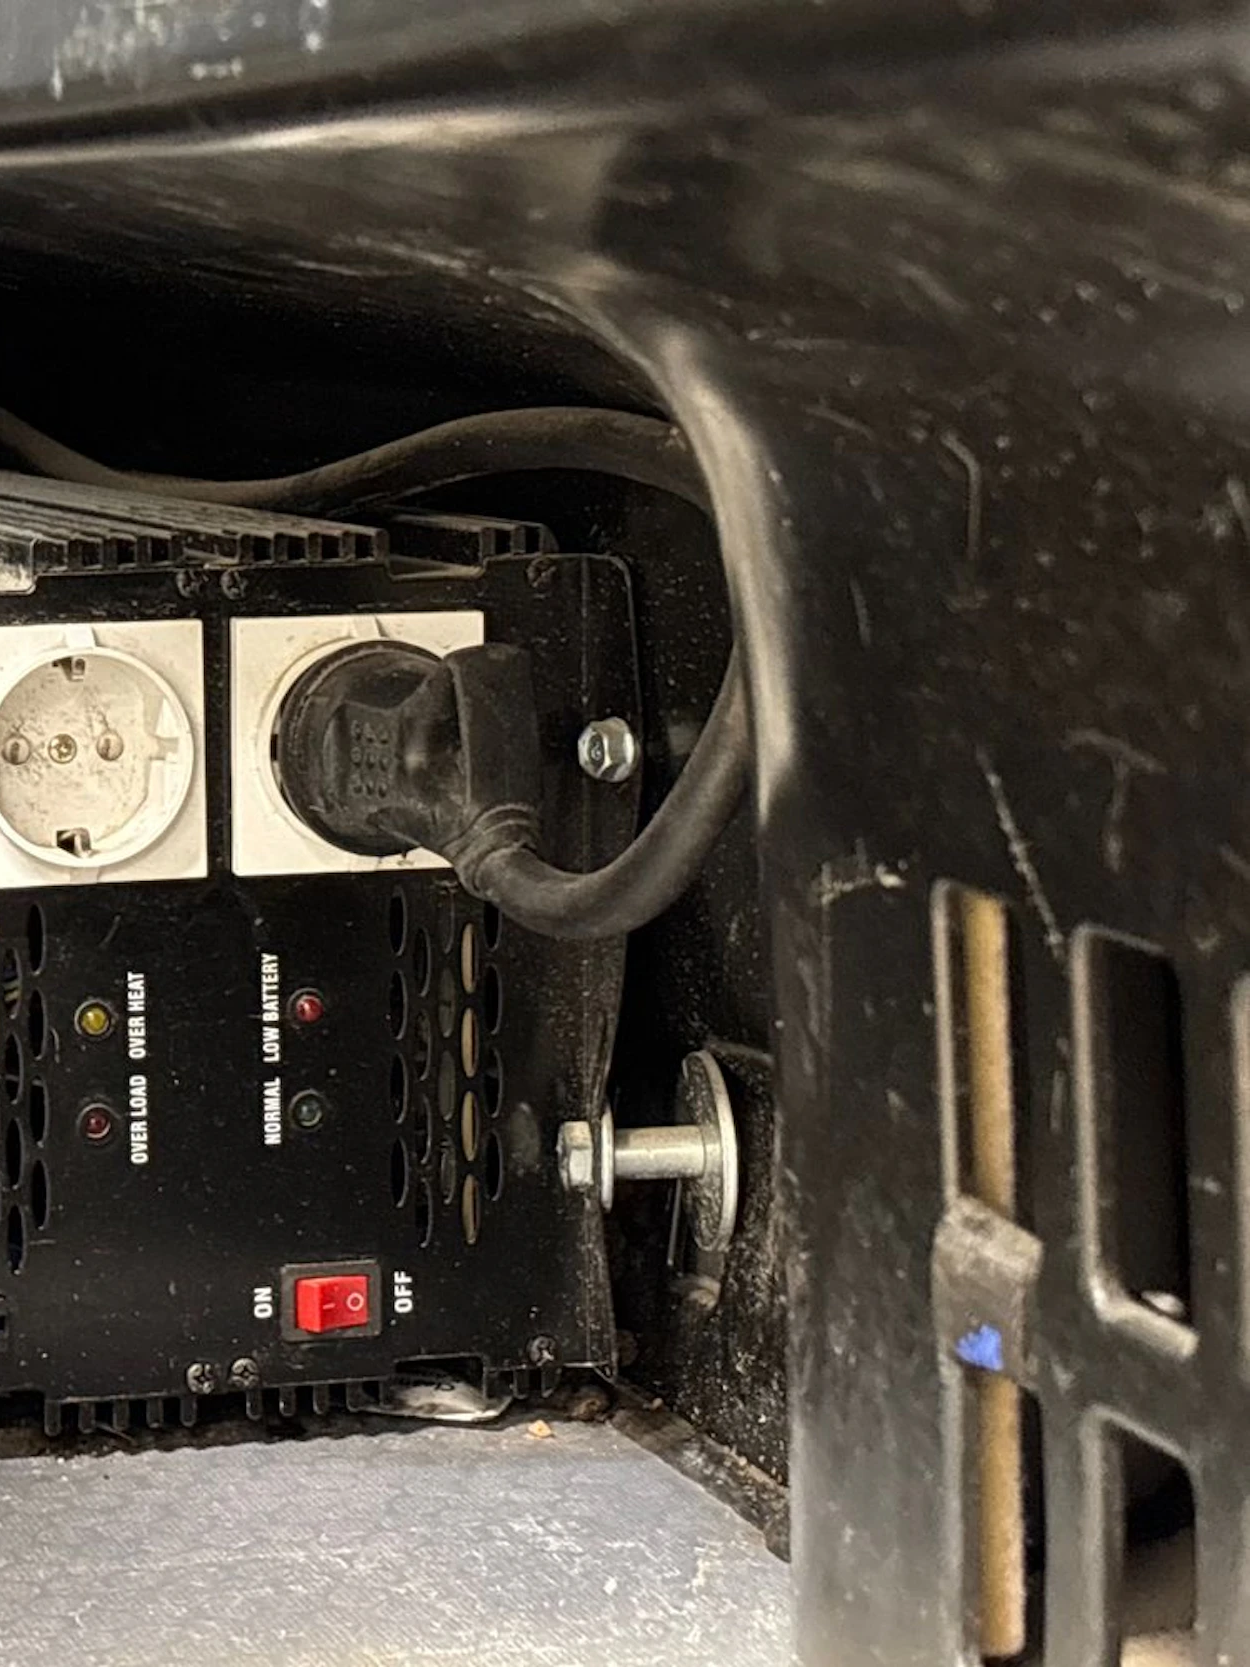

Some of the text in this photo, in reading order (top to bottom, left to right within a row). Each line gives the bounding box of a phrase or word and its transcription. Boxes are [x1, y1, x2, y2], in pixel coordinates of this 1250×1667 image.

[127, 971, 147, 1060] OVER HEAT
[261, 952, 280, 1063] LOW BATTERY
[128, 1074, 149, 1165] OVER LOAD
[263, 1076, 282, 1145] NORMAL
[253, 1286, 273, 1319] ON
[393, 1270, 414, 1314] OFF
